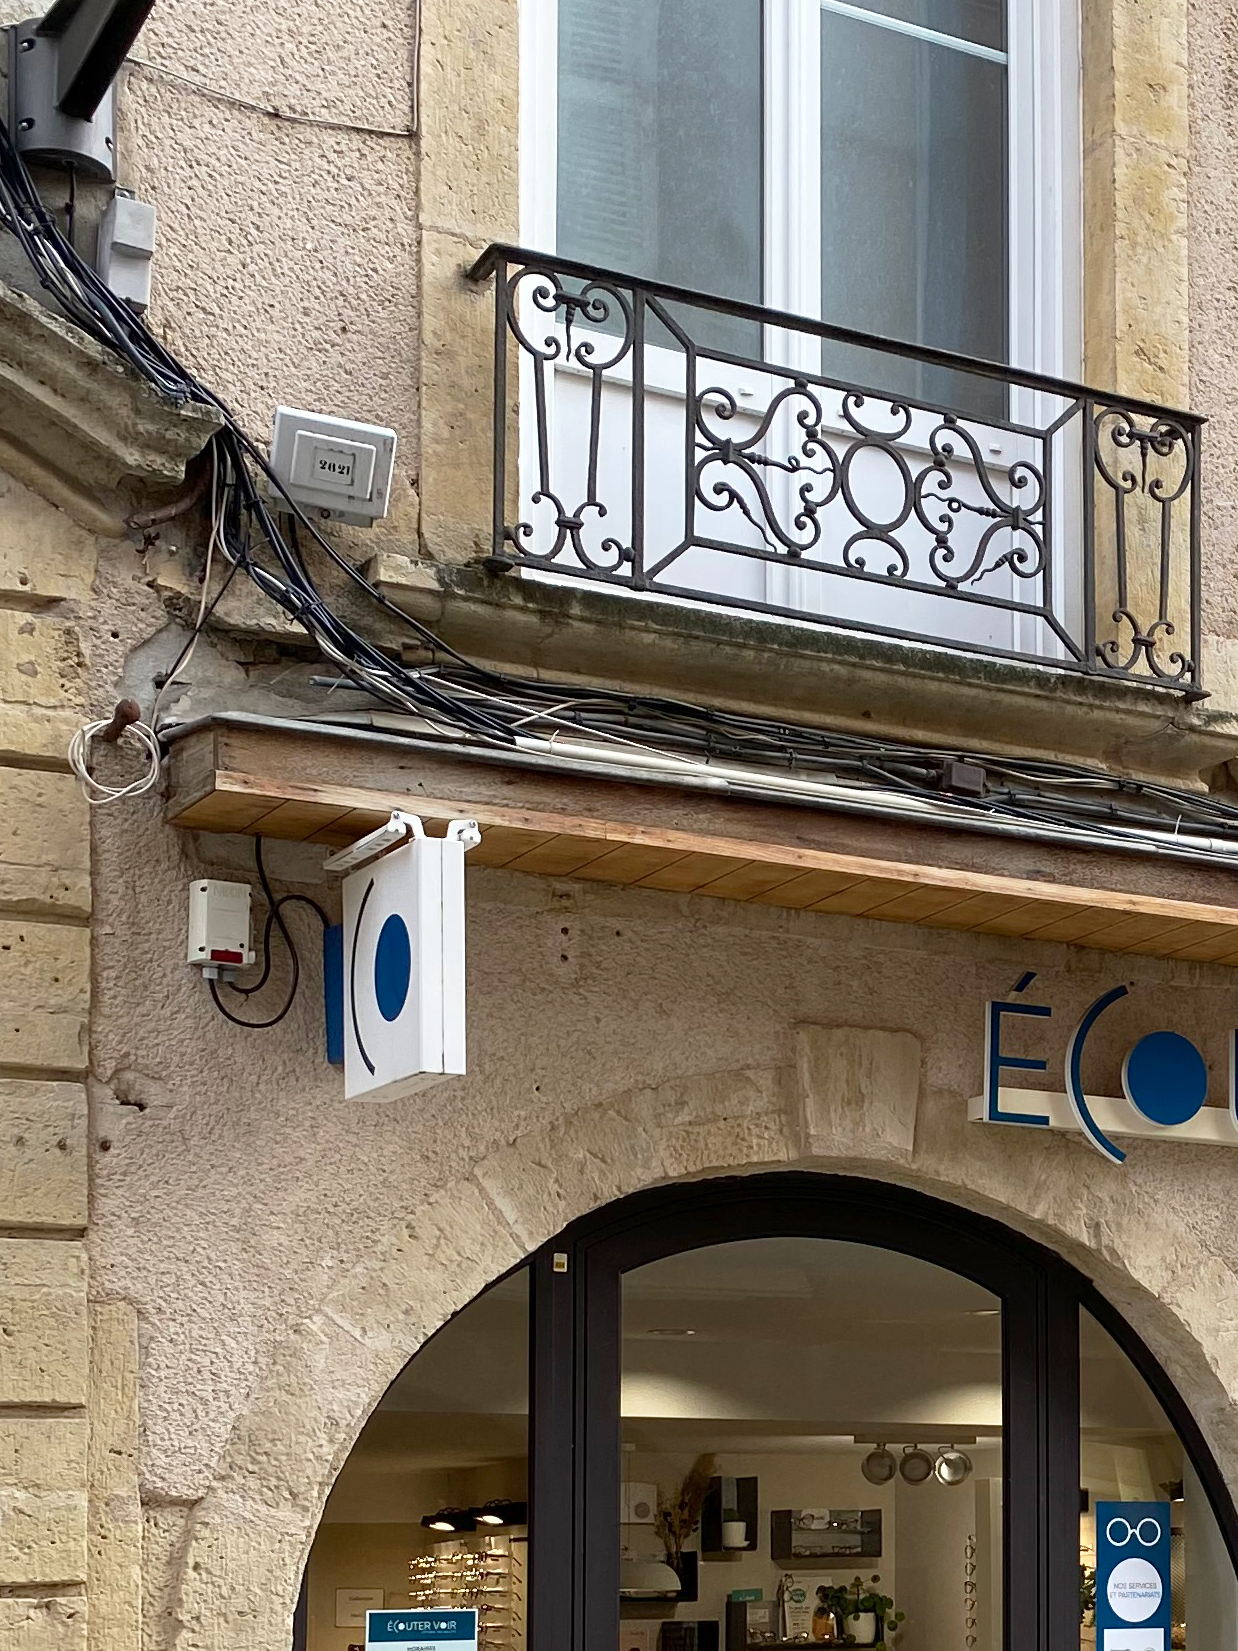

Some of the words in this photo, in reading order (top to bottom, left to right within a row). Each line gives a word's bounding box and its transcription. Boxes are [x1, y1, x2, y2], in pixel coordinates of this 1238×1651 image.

[1113, 1582, 1127, 1590] NOS
[1129, 1582, 1158, 1590] SERVICES
[1118, 1591, 1160, 1599] PARTENARIATS
[387, 1619, 431, 1633] ÉCOUTER
[433, 1620, 457, 1631] VOIR
